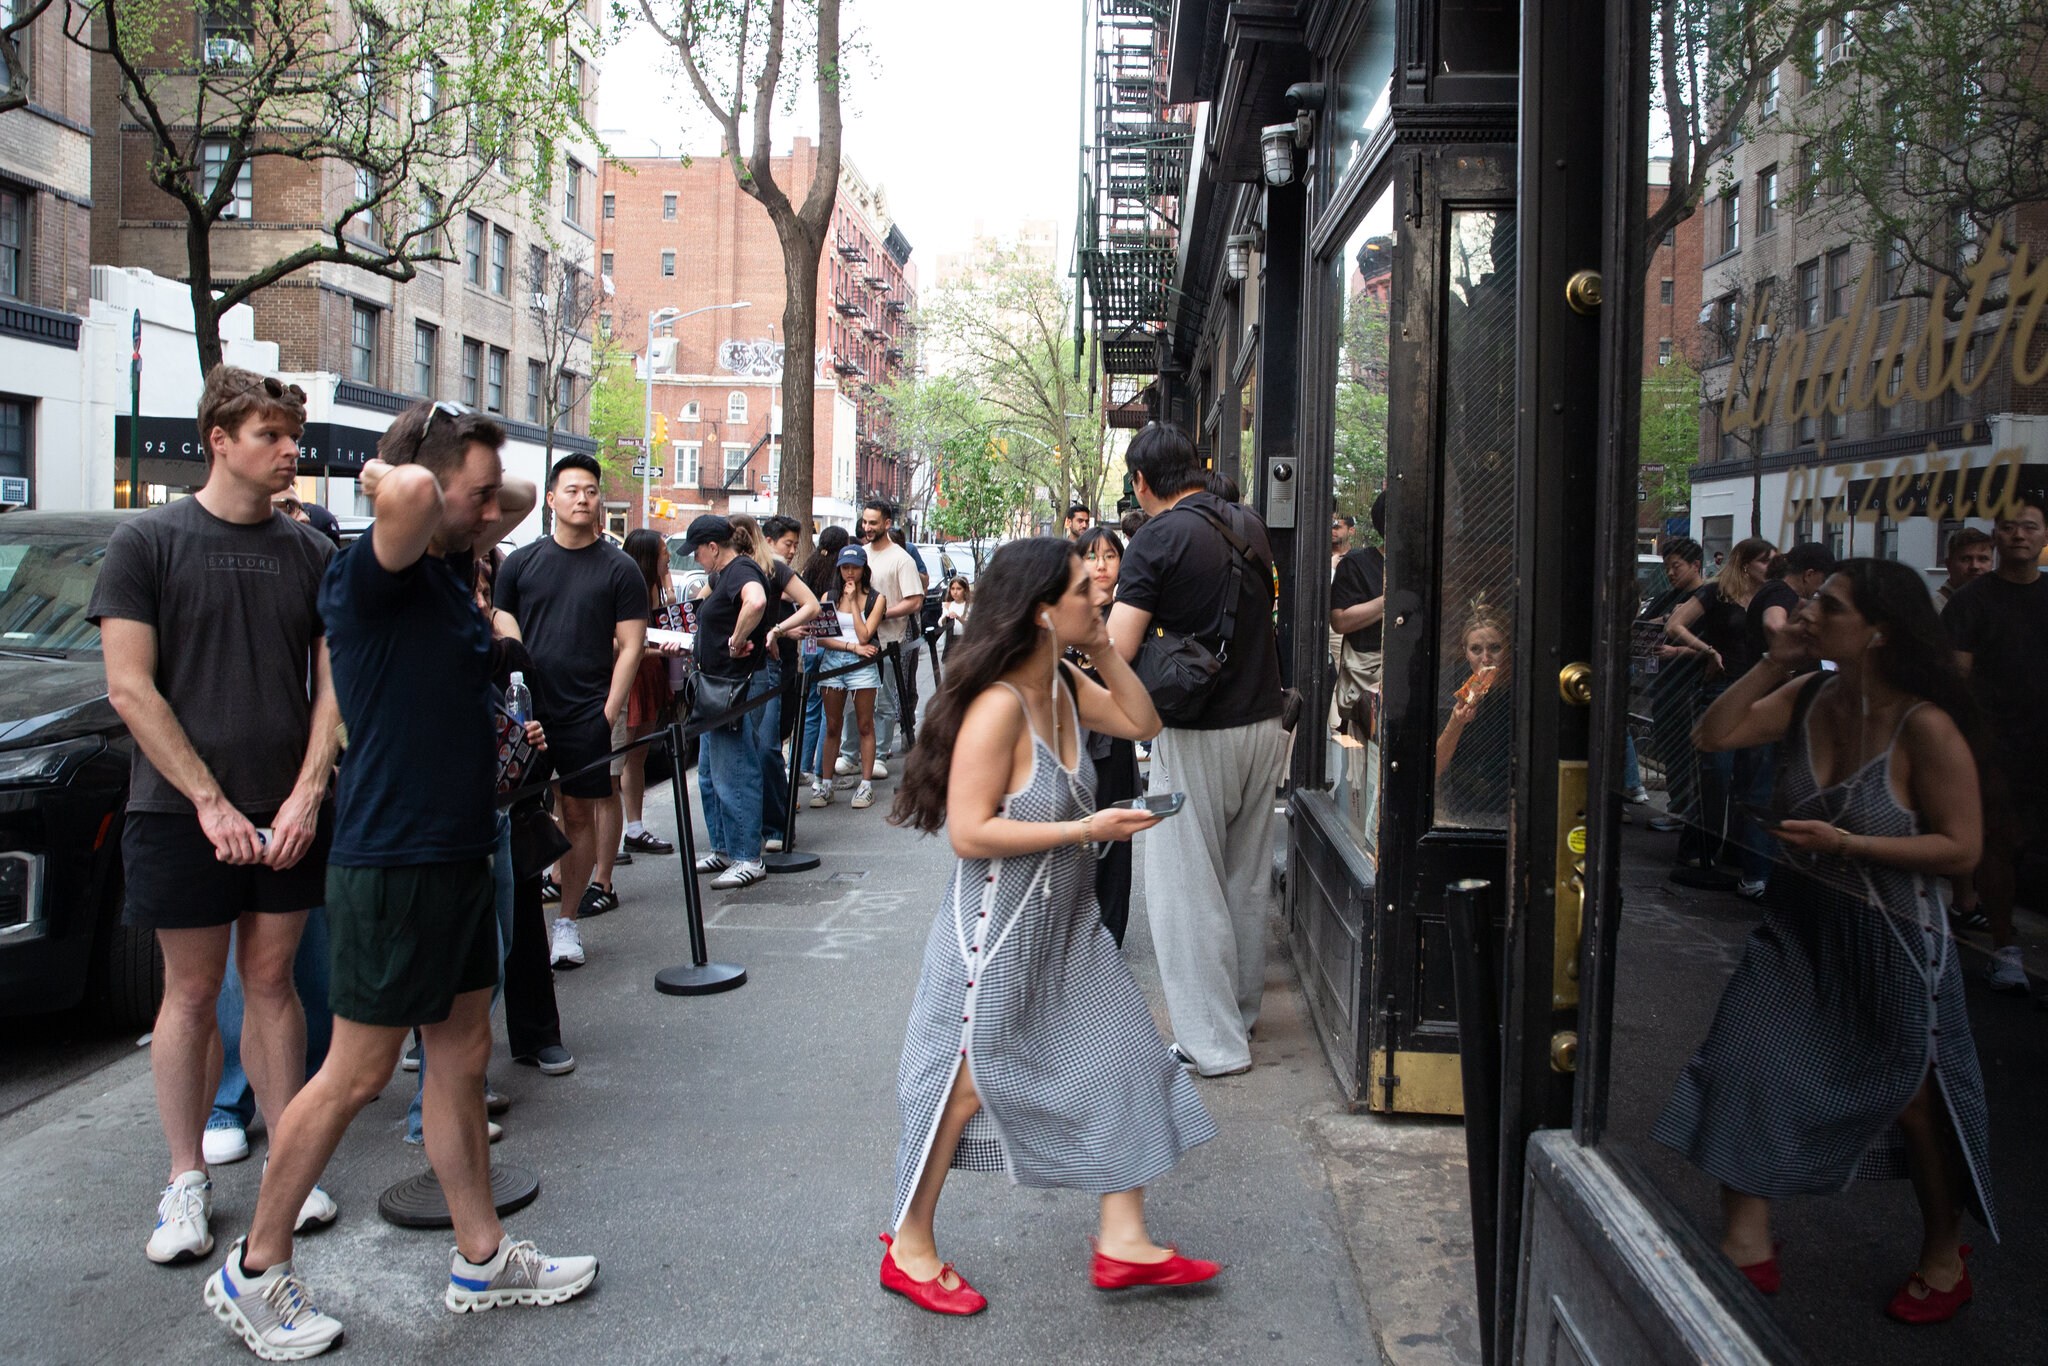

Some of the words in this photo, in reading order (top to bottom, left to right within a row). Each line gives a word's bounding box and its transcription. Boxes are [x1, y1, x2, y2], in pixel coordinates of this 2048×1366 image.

[145, 441, 166, 453] 95
[337, 448, 365, 463] THE
[1778, 423, 2025, 553] pizzeria
[208, 556, 275, 570] EXPLORE
